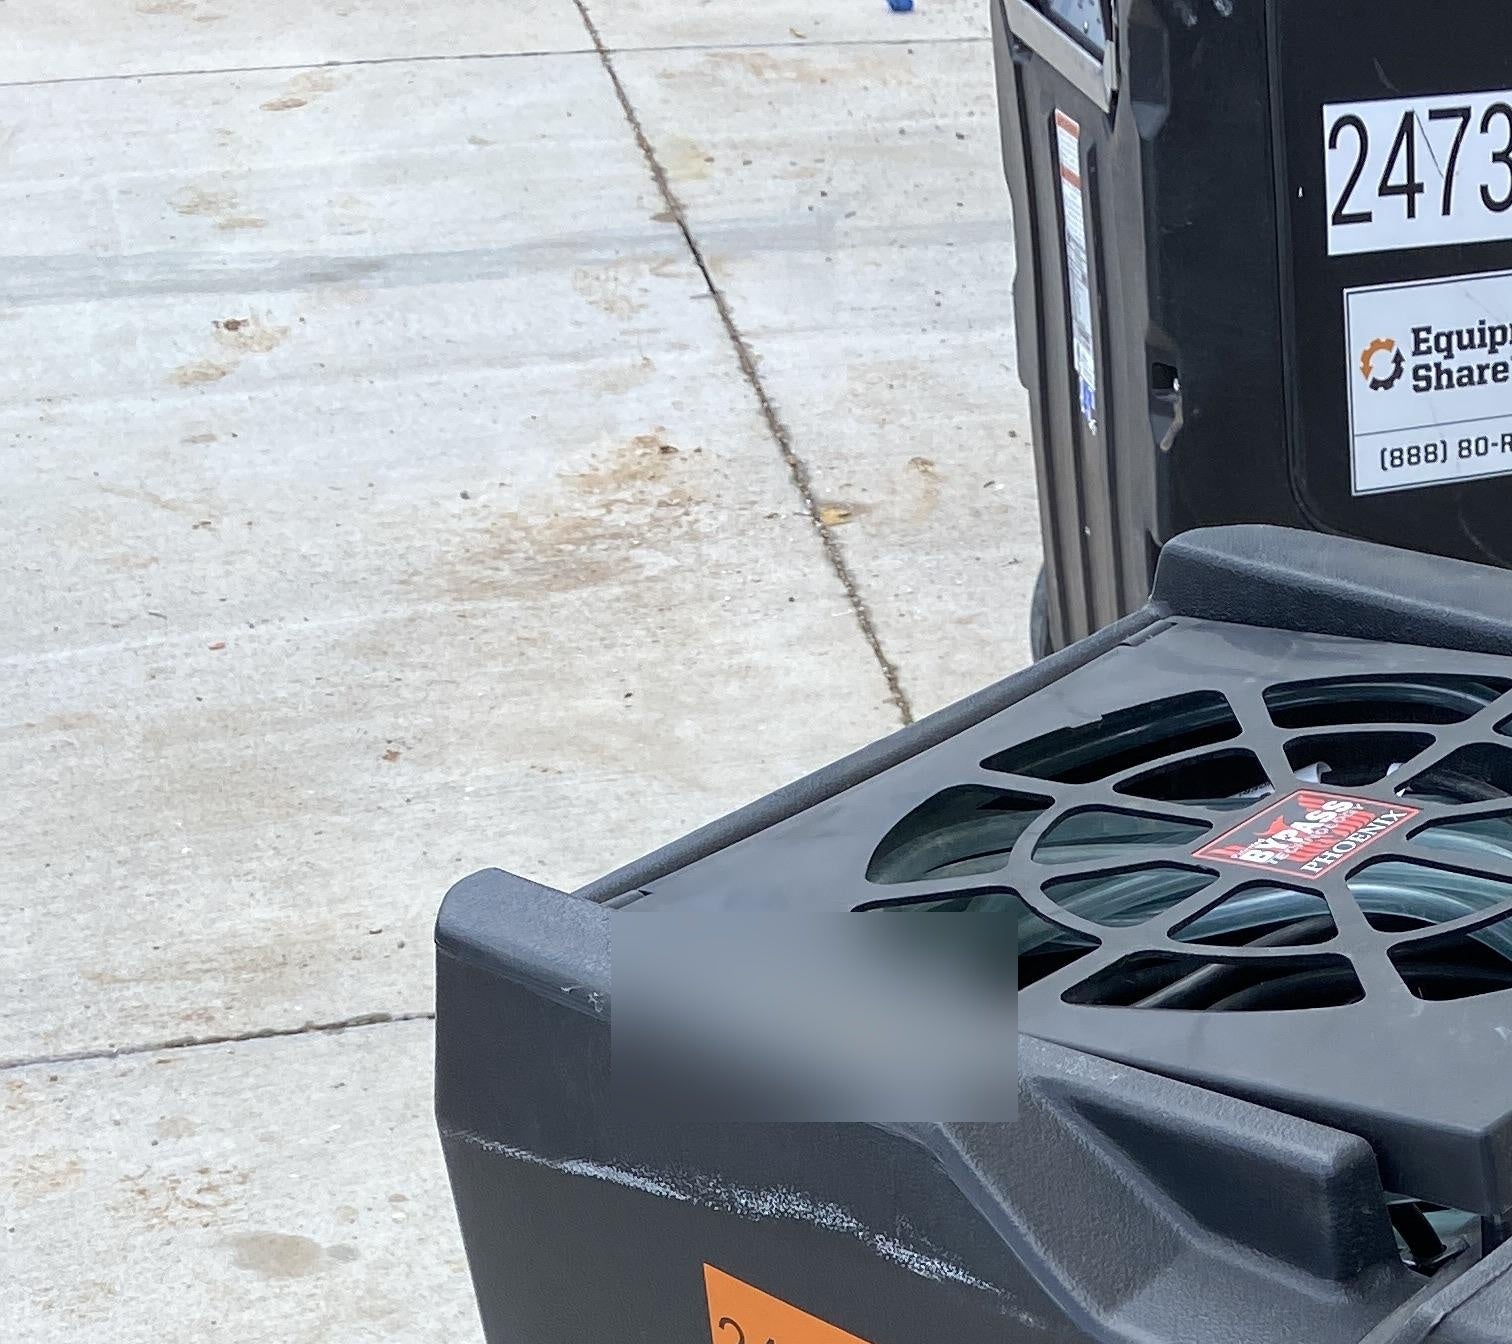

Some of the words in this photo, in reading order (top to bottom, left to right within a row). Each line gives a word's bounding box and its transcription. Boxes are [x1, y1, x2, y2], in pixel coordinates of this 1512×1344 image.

[1412, 361, 1510, 393] Share
[1380, 440, 1448, 471] (888)
[1234, 798, 1363, 864] BYPASS
[1296, 809, 1411, 873] PHOENIX
